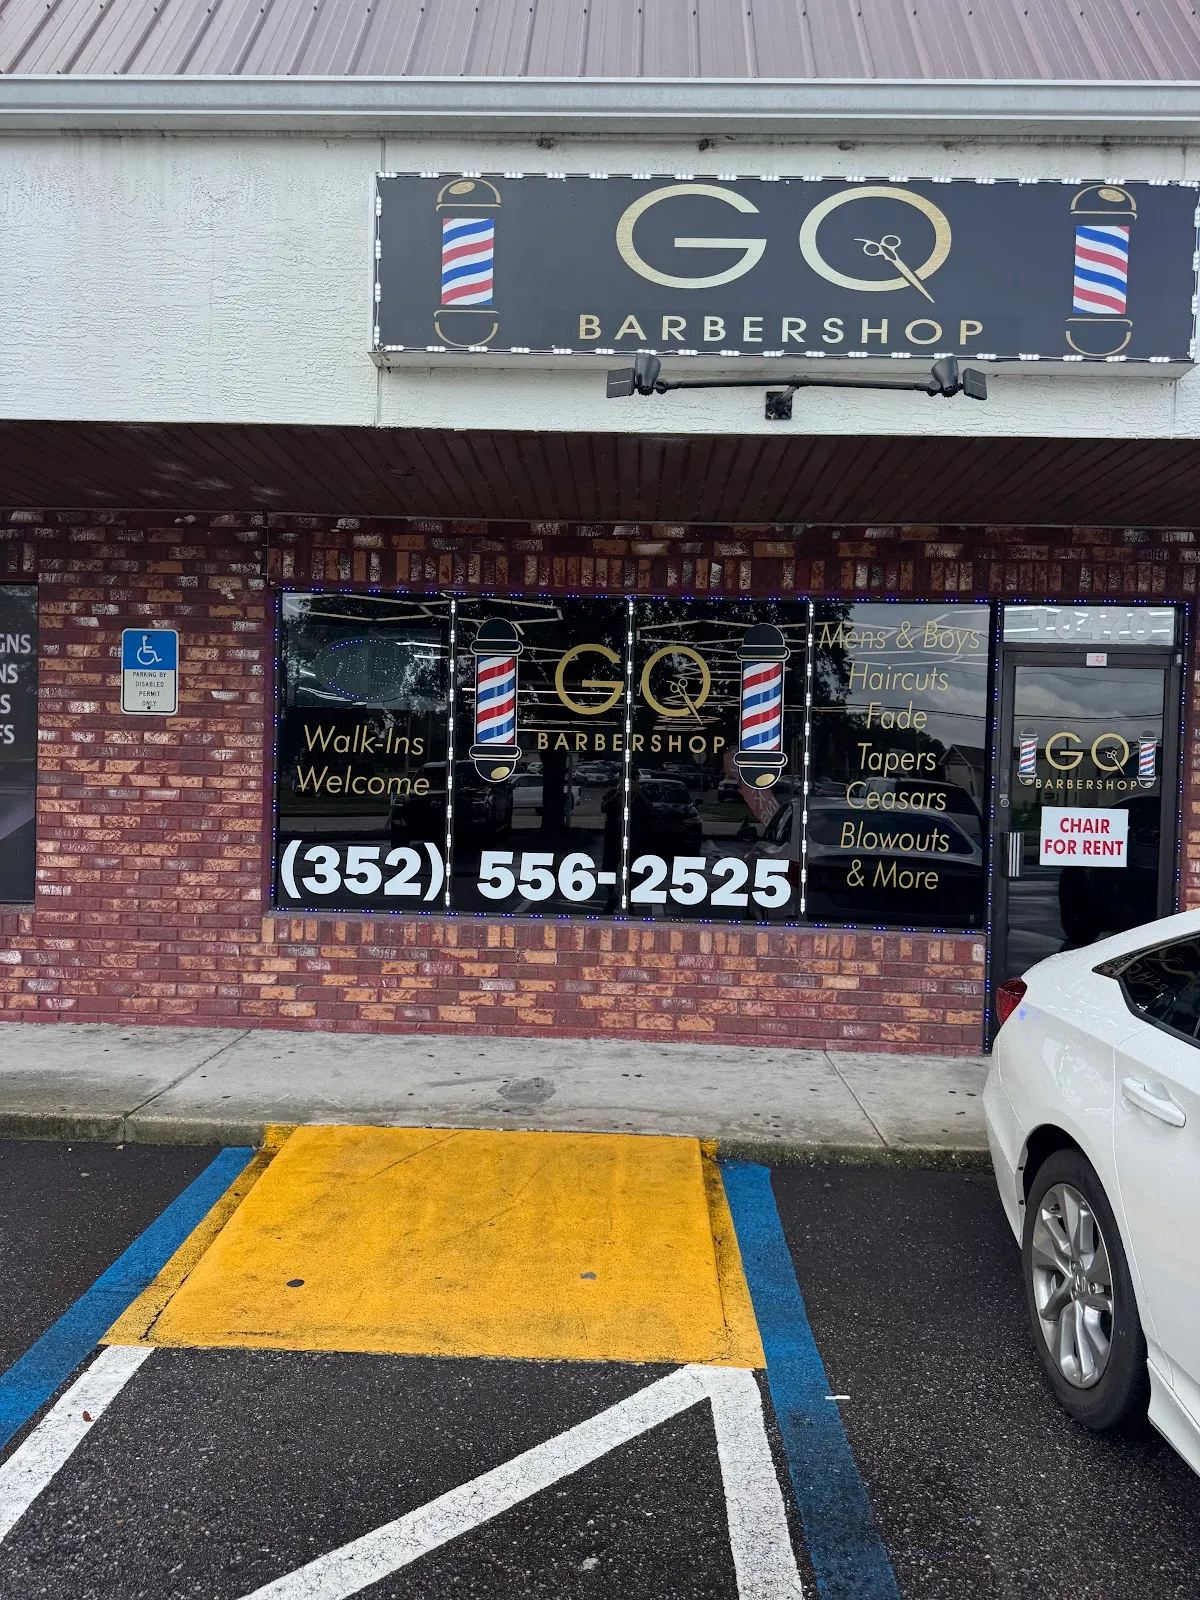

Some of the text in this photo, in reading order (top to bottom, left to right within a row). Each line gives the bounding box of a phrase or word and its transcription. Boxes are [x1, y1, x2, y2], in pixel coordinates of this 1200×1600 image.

[615, 183, 952, 304] GQ
[578, 314, 984, 346] BARBERSHOP
[819, 621, 980, 655] Mens & Boys
[1030, 608, 1153, 641] 10476
[555, 643, 711, 725] GQ
[848, 663, 949, 692] Haircuts
[865, 701, 928, 730] Fade
[303, 725, 425, 756] Walk-Ins
[537, 732, 726, 754] BARBERSHOP
[1045, 732, 1130, 776] GQ
[857, 743, 937, 778] Tapers
[297, 766, 430, 796] Welcome
[846, 781, 947, 811] Ceasars
[1035, 778, 1138, 791] BARBERSHOP
[840, 821, 950, 853] Blowouts
[1059, 817, 1110, 834] CHAIR
[1044, 839, 1124, 856] FOR RENT
[280, 840, 444, 901] (352)
[630, 854, 791, 909] 2525
[847, 859, 939, 890] & More
